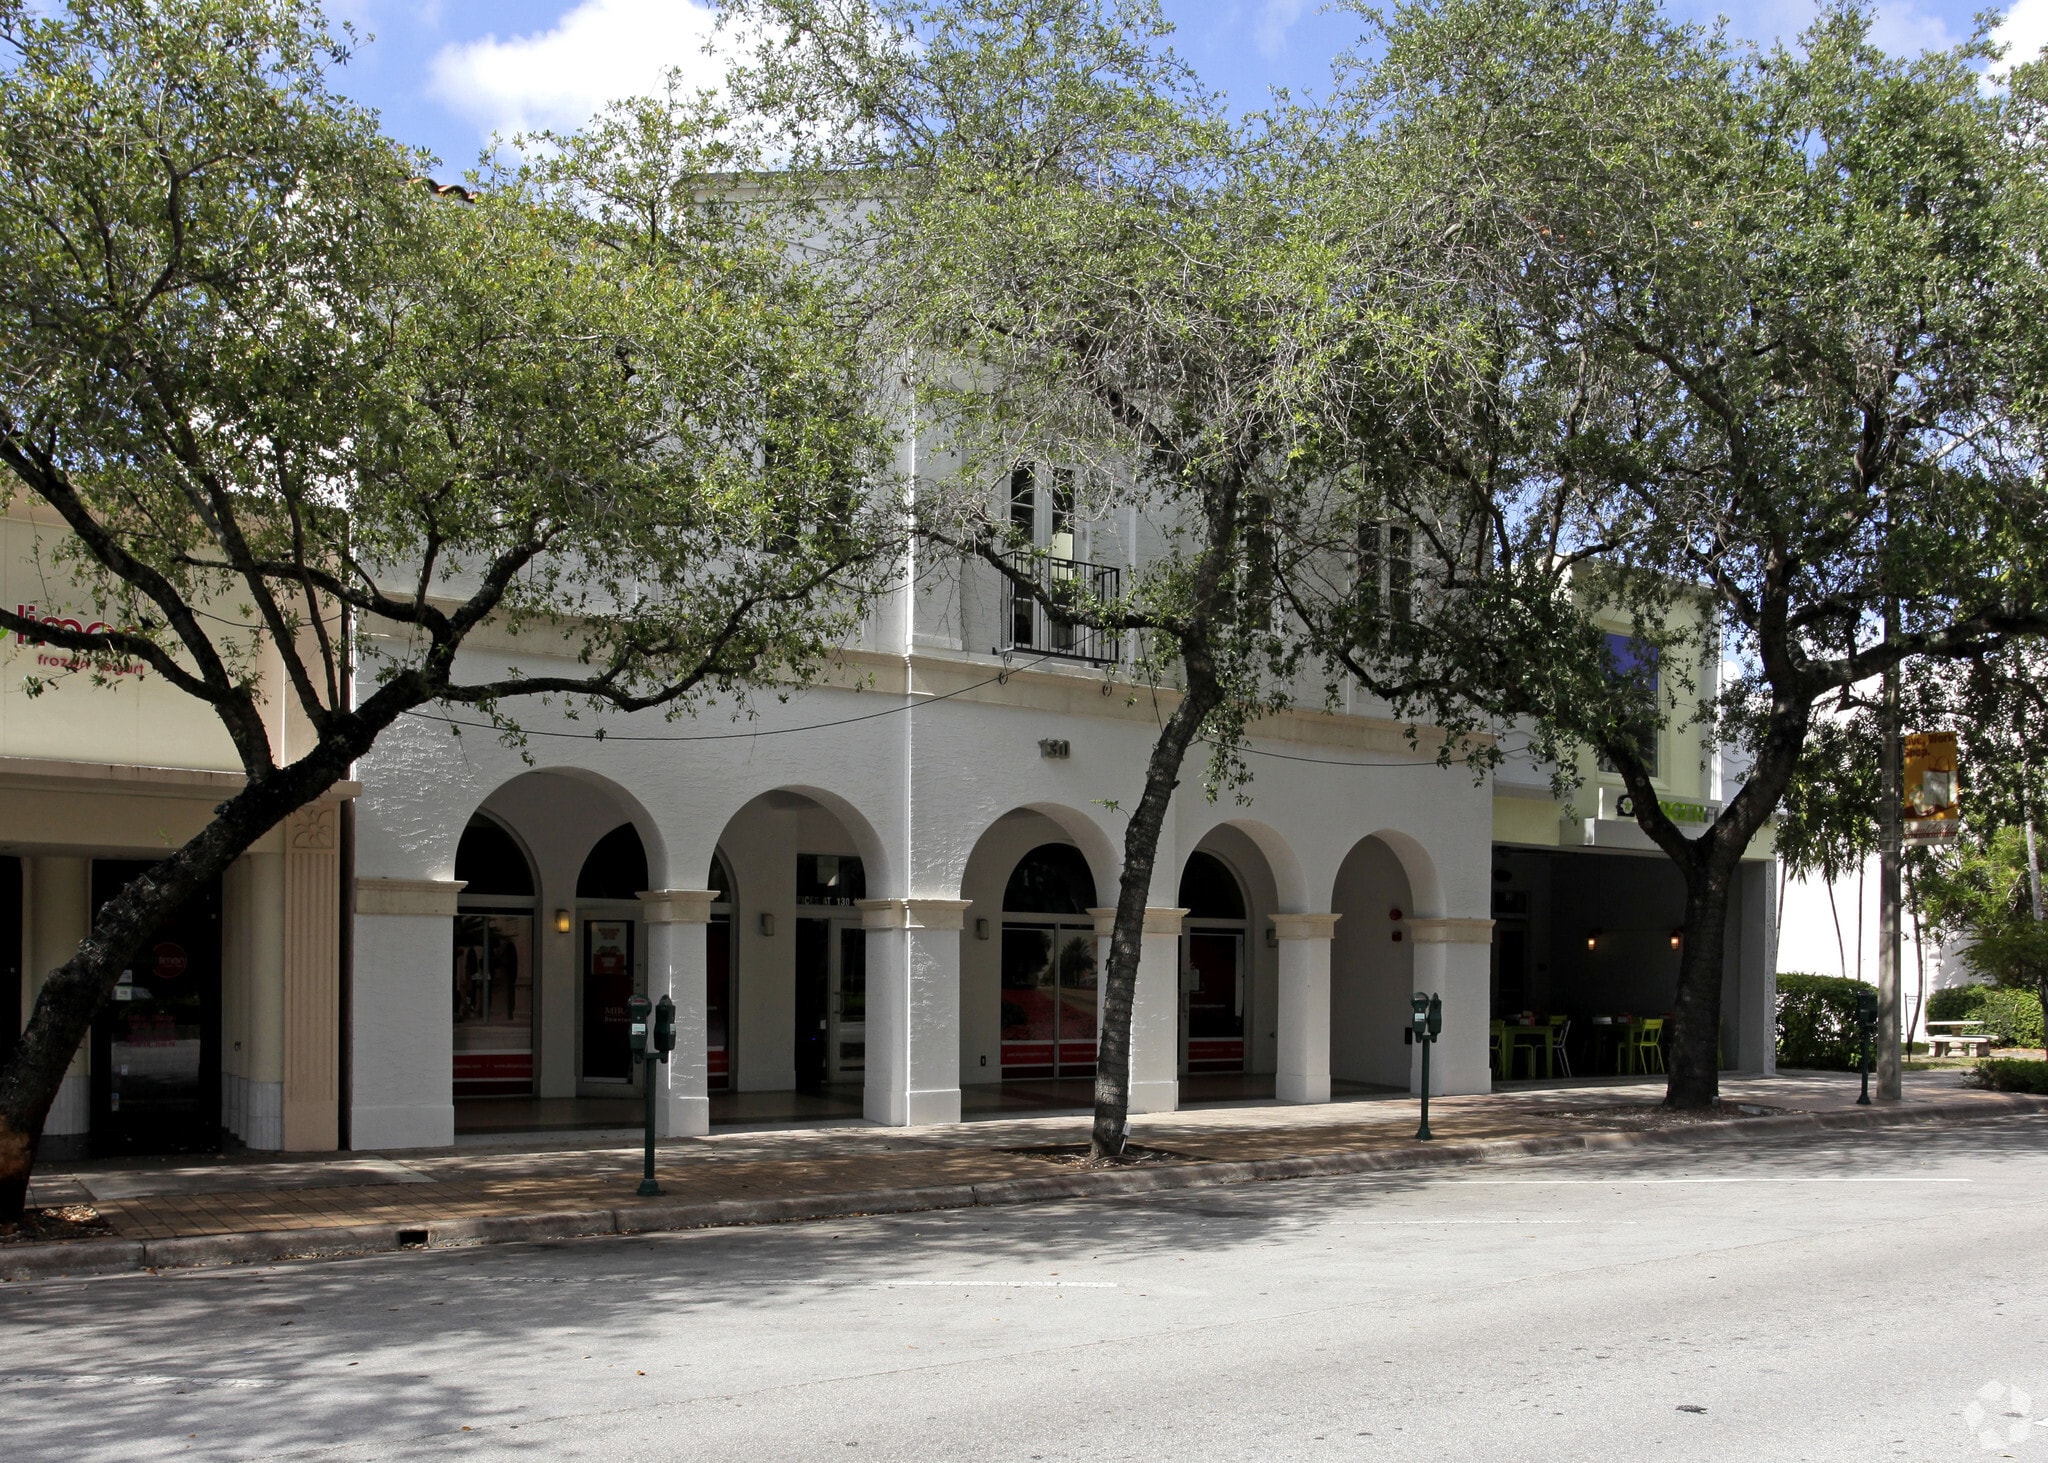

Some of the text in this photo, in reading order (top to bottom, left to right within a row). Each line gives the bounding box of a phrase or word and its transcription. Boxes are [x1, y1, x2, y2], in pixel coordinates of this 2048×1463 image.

[98, 661, 145, 676] ogurt
[1037, 737, 1071, 760] 130
[1904, 748, 1931, 759] Shop.
[1656, 799, 1720, 824] RGERFI
[837, 897, 850, 906] 130
